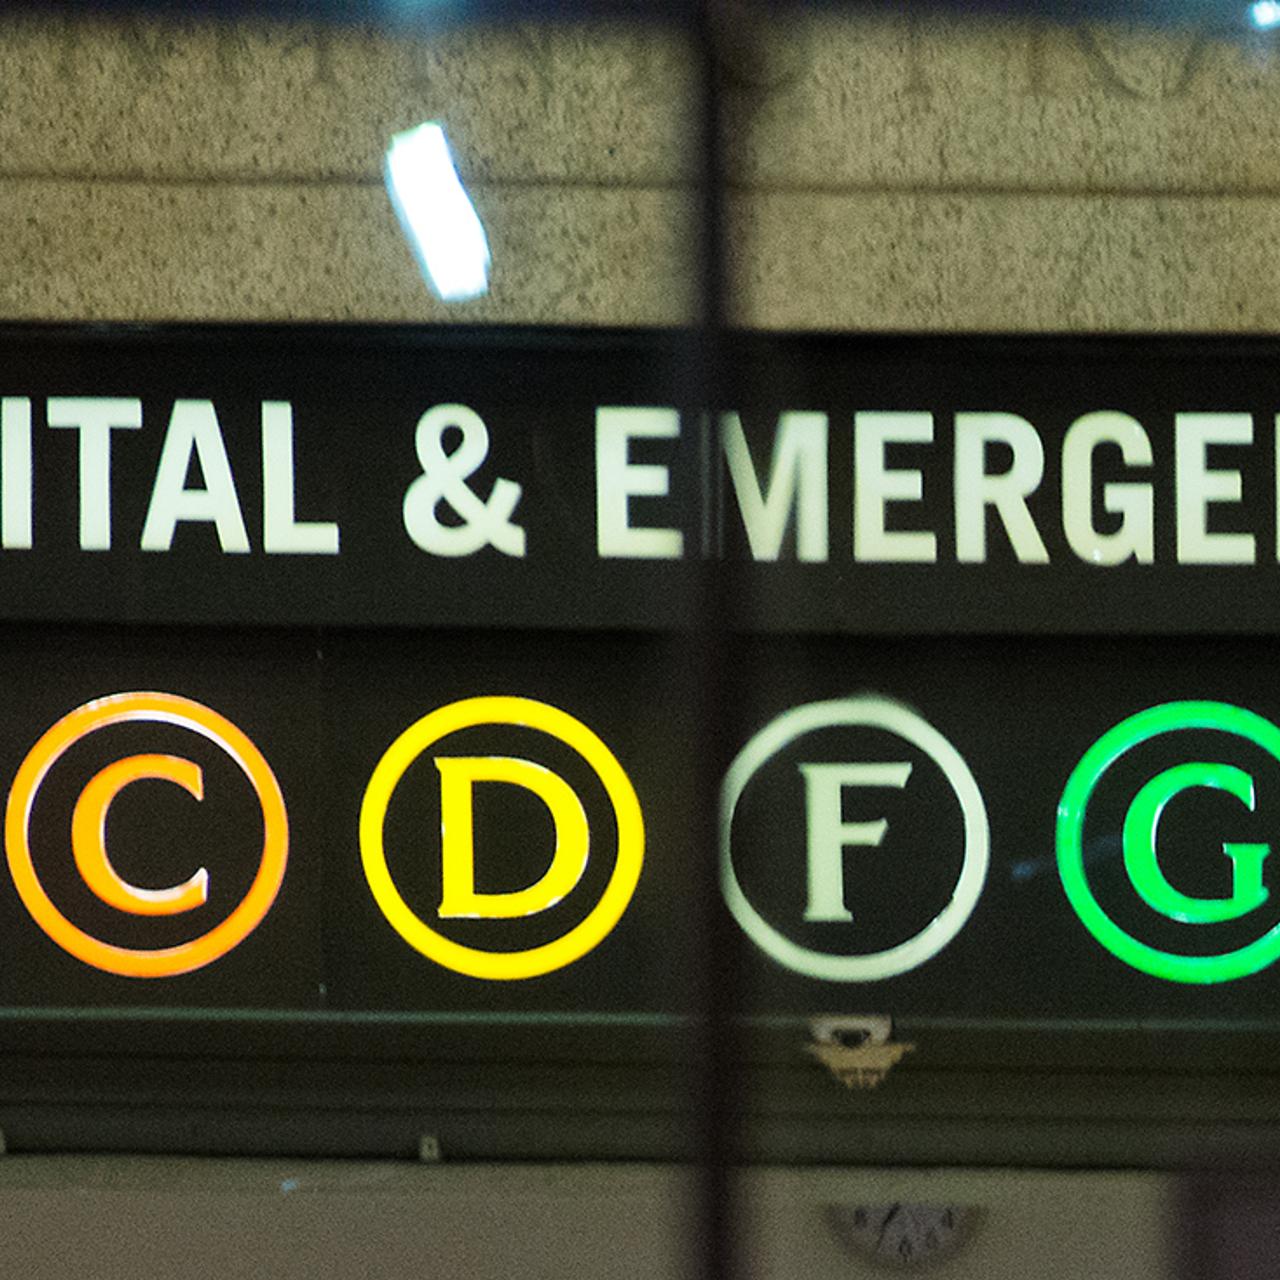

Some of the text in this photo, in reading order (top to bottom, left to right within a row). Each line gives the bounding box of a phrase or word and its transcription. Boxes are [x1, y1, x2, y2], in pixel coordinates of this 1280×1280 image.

[0, 396, 340, 555] ITAL
[402, 403, 527, 558] &
[71, 753, 209, 916] C
[434, 755, 591, 920] D
[799, 761, 913, 923] F
[1122, 761, 1271, 925] G
